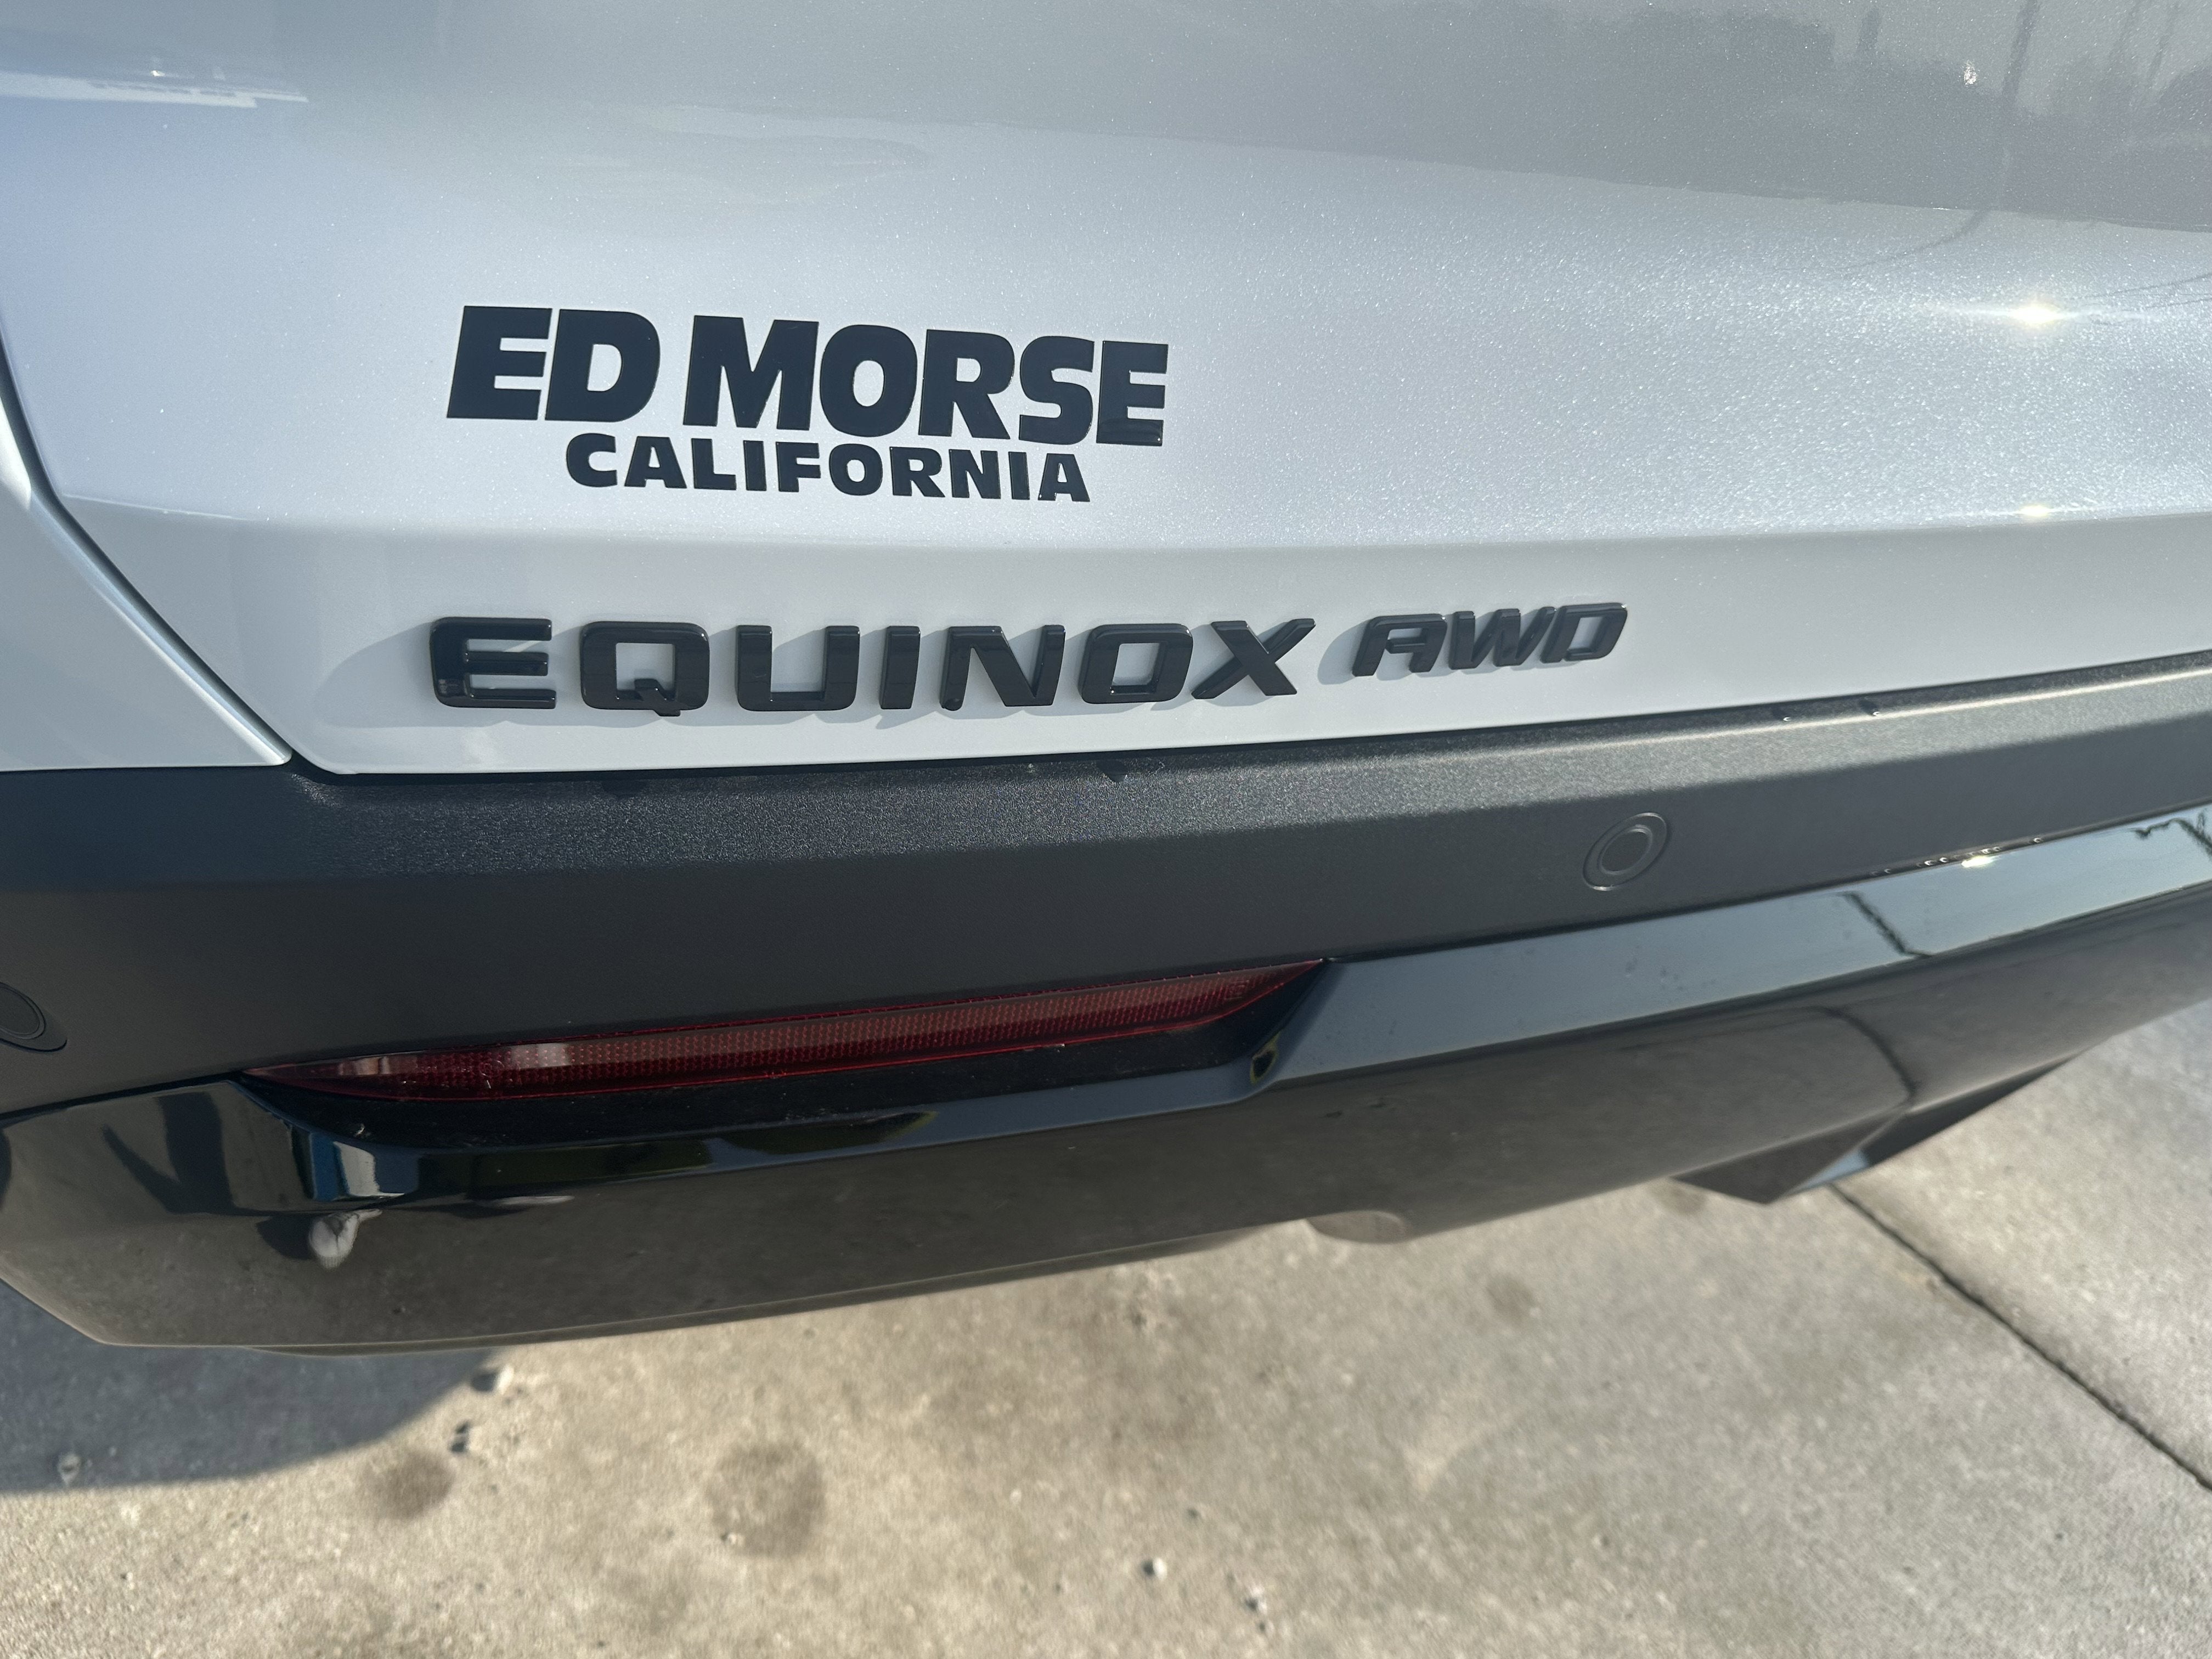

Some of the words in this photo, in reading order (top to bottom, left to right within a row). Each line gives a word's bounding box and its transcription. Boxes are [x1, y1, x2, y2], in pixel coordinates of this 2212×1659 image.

[447, 306, 660, 424] ED
[684, 315, 1169, 447] MORSE
[566, 433, 1091, 503] CALIFORNIA
[430, 616, 1314, 716] EQUINOX
[1352, 602, 1627, 676] AWD
